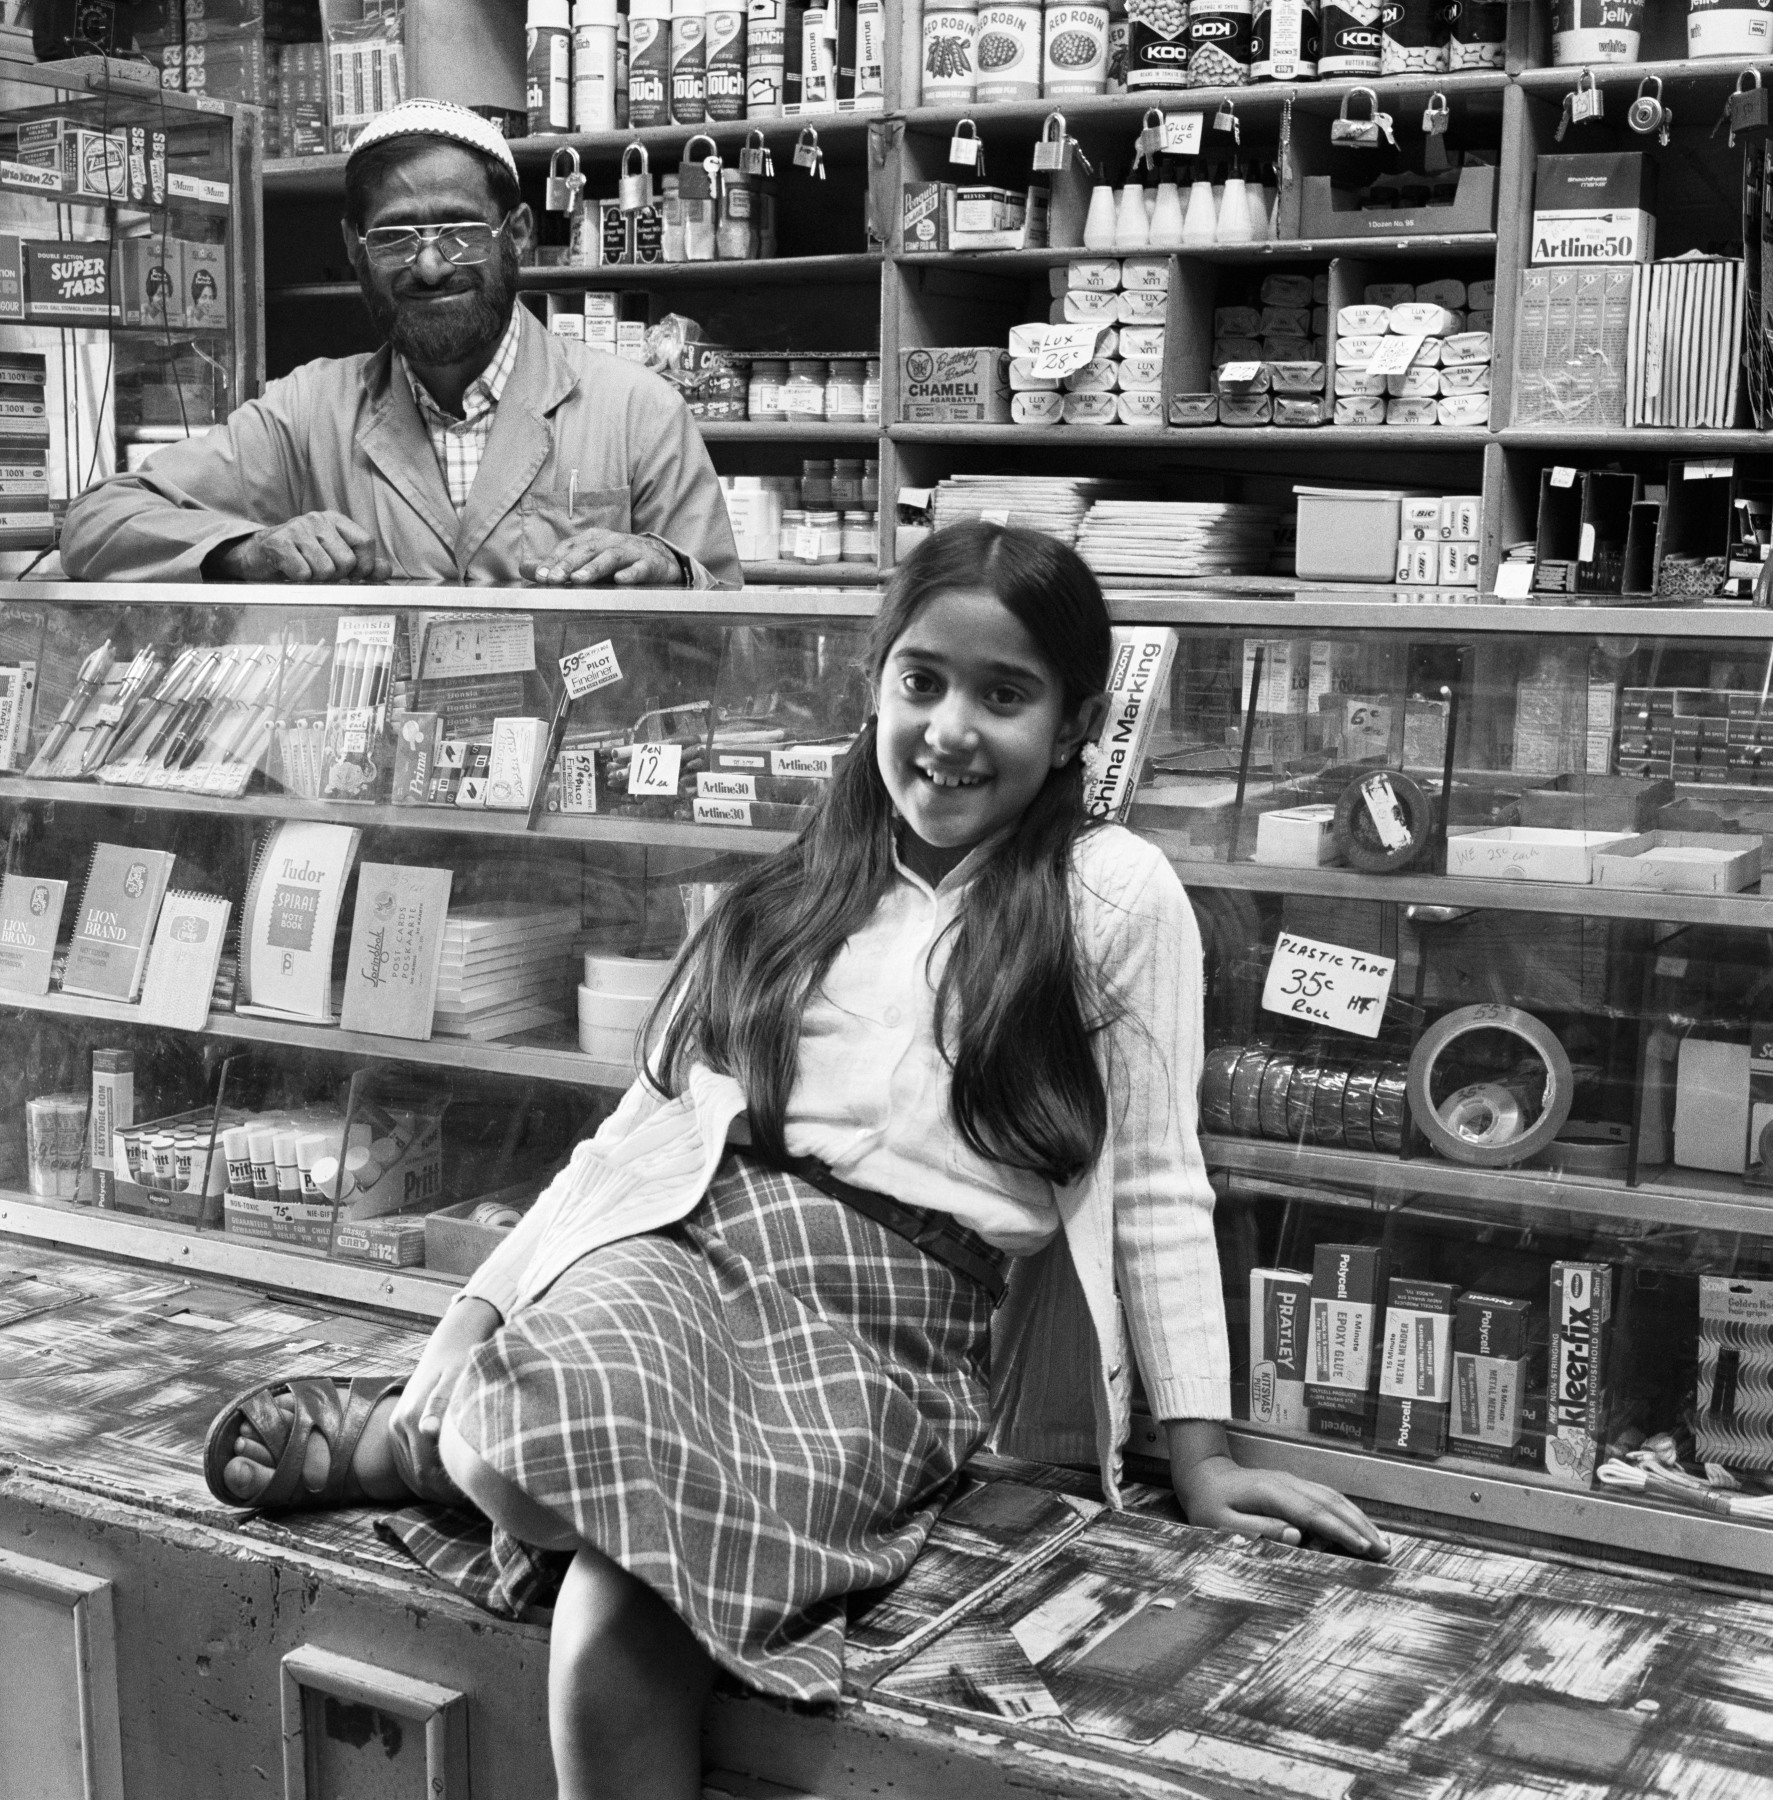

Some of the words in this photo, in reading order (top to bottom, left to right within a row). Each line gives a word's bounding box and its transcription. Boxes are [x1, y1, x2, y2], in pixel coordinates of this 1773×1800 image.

[1049, 12, 1068, 32] RED
[1070, 10, 1105, 32] ROBIN
[1600, 7, 1633, 27] jelly
[865, 20, 873, 61] BATHTUB
[1599, 40, 1627, 54] white
[1148, 46, 1187, 60] KOO
[706, 71, 745, 95] Touch
[173, 180, 194, 192] Mum
[204, 186, 225, 198] Mum
[38, 252, 60, 260] DOUBLE
[1534, 236, 1633, 259] Artline50
[51, 258, 106, 281] SUPER
[1044, 335, 1073, 346] LUX
[908, 384, 978, 397] CHAMELI
[586, 656, 610, 671] PILOT
[572, 666, 613, 688] Fineliner
[1090, 750, 1126, 819] China
[1113, 643, 1161, 743] Marking
[410, 752, 427, 796] Prima
[778, 758, 828, 773] Artline30
[567, 758, 575, 805] Fineliner
[702, 782, 749, 796] Artline30
[698, 808, 744, 821] Artline30
[282, 858, 326, 883] Tudor
[278, 892, 315, 912] SPIRAL
[4, 919, 29, 933] LION
[87, 908, 119, 926] LION
[281, 920, 303, 930] BOOK
[282, 912, 303, 922] NOTE
[396, 907, 407, 943] CARDS
[1, 930, 36, 946] BRAND
[84, 924, 127, 941] BRAND
[402, 908, 417, 979] POSKAARTE
[392, 951, 401, 978] POST
[1278, 938, 1344, 967] PLASTIC
[1350, 956, 1389, 978] TAPE
[1280, 968, 1335, 997] 35c
[98, 1085, 106, 1104] GOM
[98, 1106, 107, 1157] ALSYDIGE
[98, 1172, 106, 1208] Polycell
[404, 1162, 441, 1202] Pritt
[230, 1200, 259, 1212] NON-TOXIC
[232, 1217, 268, 1229] GUARANTEED
[294, 1226, 306, 1234] FOR
[1338, 1254, 1350, 1299] Polycell
[1593, 1277, 1601, 1297] 30ml
[1468, 1294, 1514, 1305] Polycell
[1728, 1298, 1754, 1310] Golden
[1728, 1306, 1742, 1316] hair
[1745, 1309, 1768, 1319] grips
[1276, 1291, 1297, 1371] PRATLEY
[1335, 1312, 1348, 1348] EPOXY
[1353, 1322, 1362, 1352] Minute
[1399, 1322, 1409, 1357] MENDER
[1480, 1310, 1492, 1354] Polycell
[1388, 1333, 1396, 1361] Minute
[1333, 1350, 1345, 1378] GLUE
[1396, 1358, 1404, 1385] METAL
[1551, 1334, 1559, 1403] NON-STRINGING
[1558, 1306, 1591, 1428] kleer-fix
[1590, 1337, 1599, 1397] HOUSEHOLD
[1261, 1372, 1271, 1414] KITSVAS
[1489, 1370, 1497, 1394] METAL
[1486, 1396, 1496, 1431] MENDER
[1500, 1394, 1508, 1421] Minute
[1588, 1399, 1596, 1431] CLEAR
[1398, 1401, 1412, 1447] Polycell
